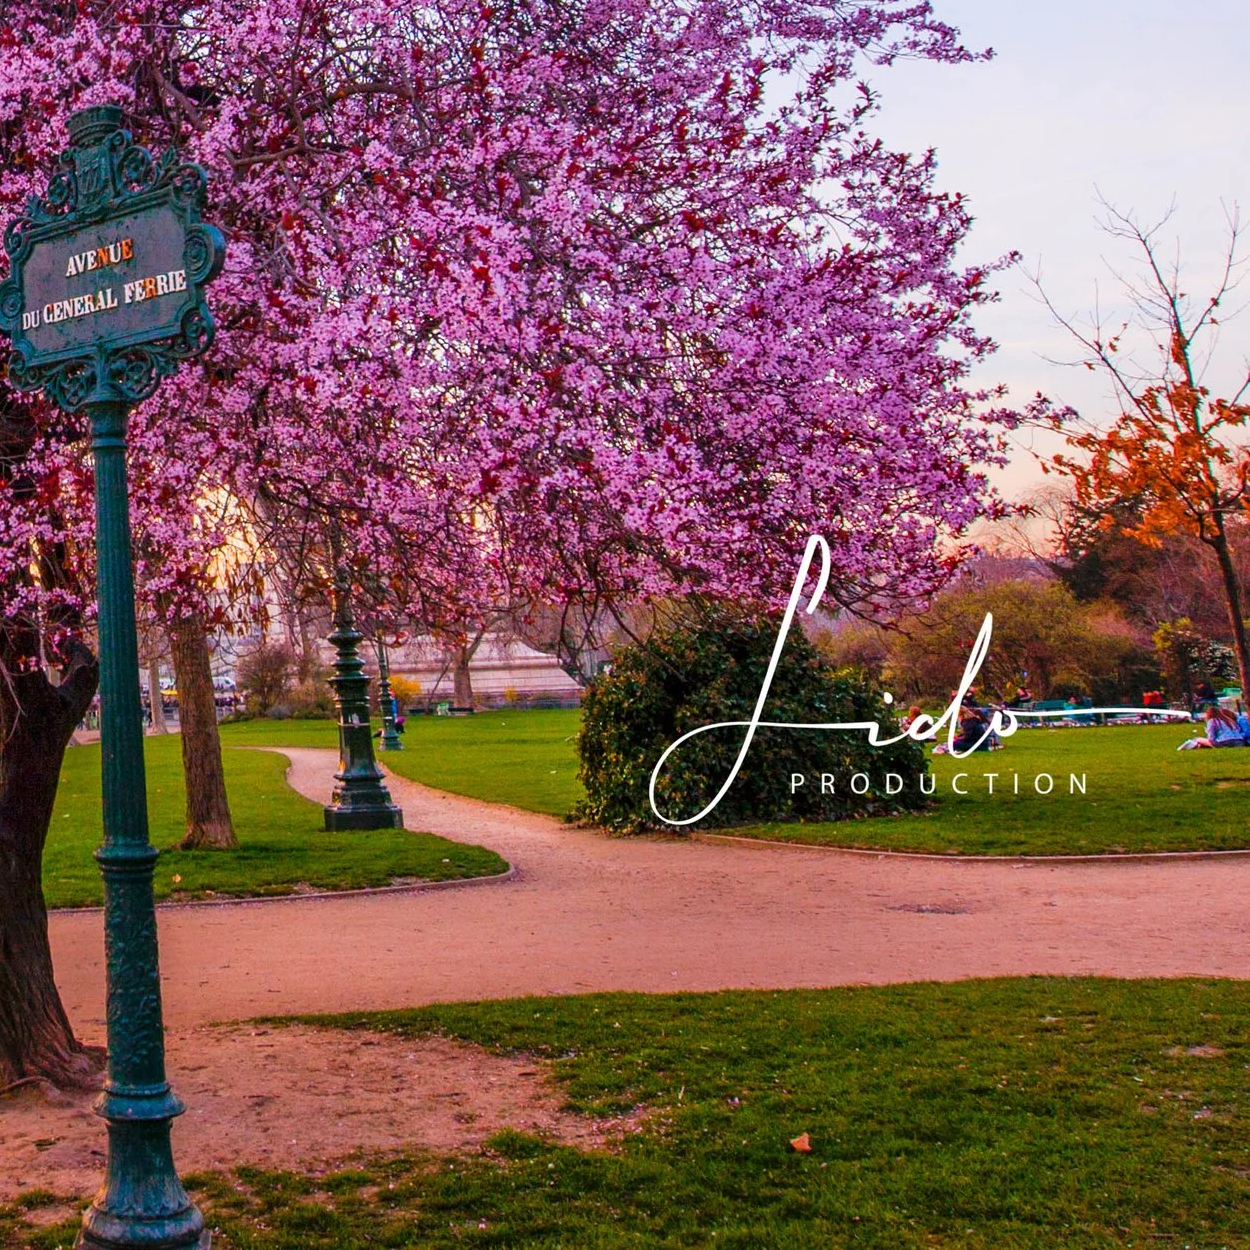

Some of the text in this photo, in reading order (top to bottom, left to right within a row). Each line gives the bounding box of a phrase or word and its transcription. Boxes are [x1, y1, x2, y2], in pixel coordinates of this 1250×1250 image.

[65, 238, 133, 277] AVENUE
[22, 270, 187, 330] DU GENERAL FERRIE
